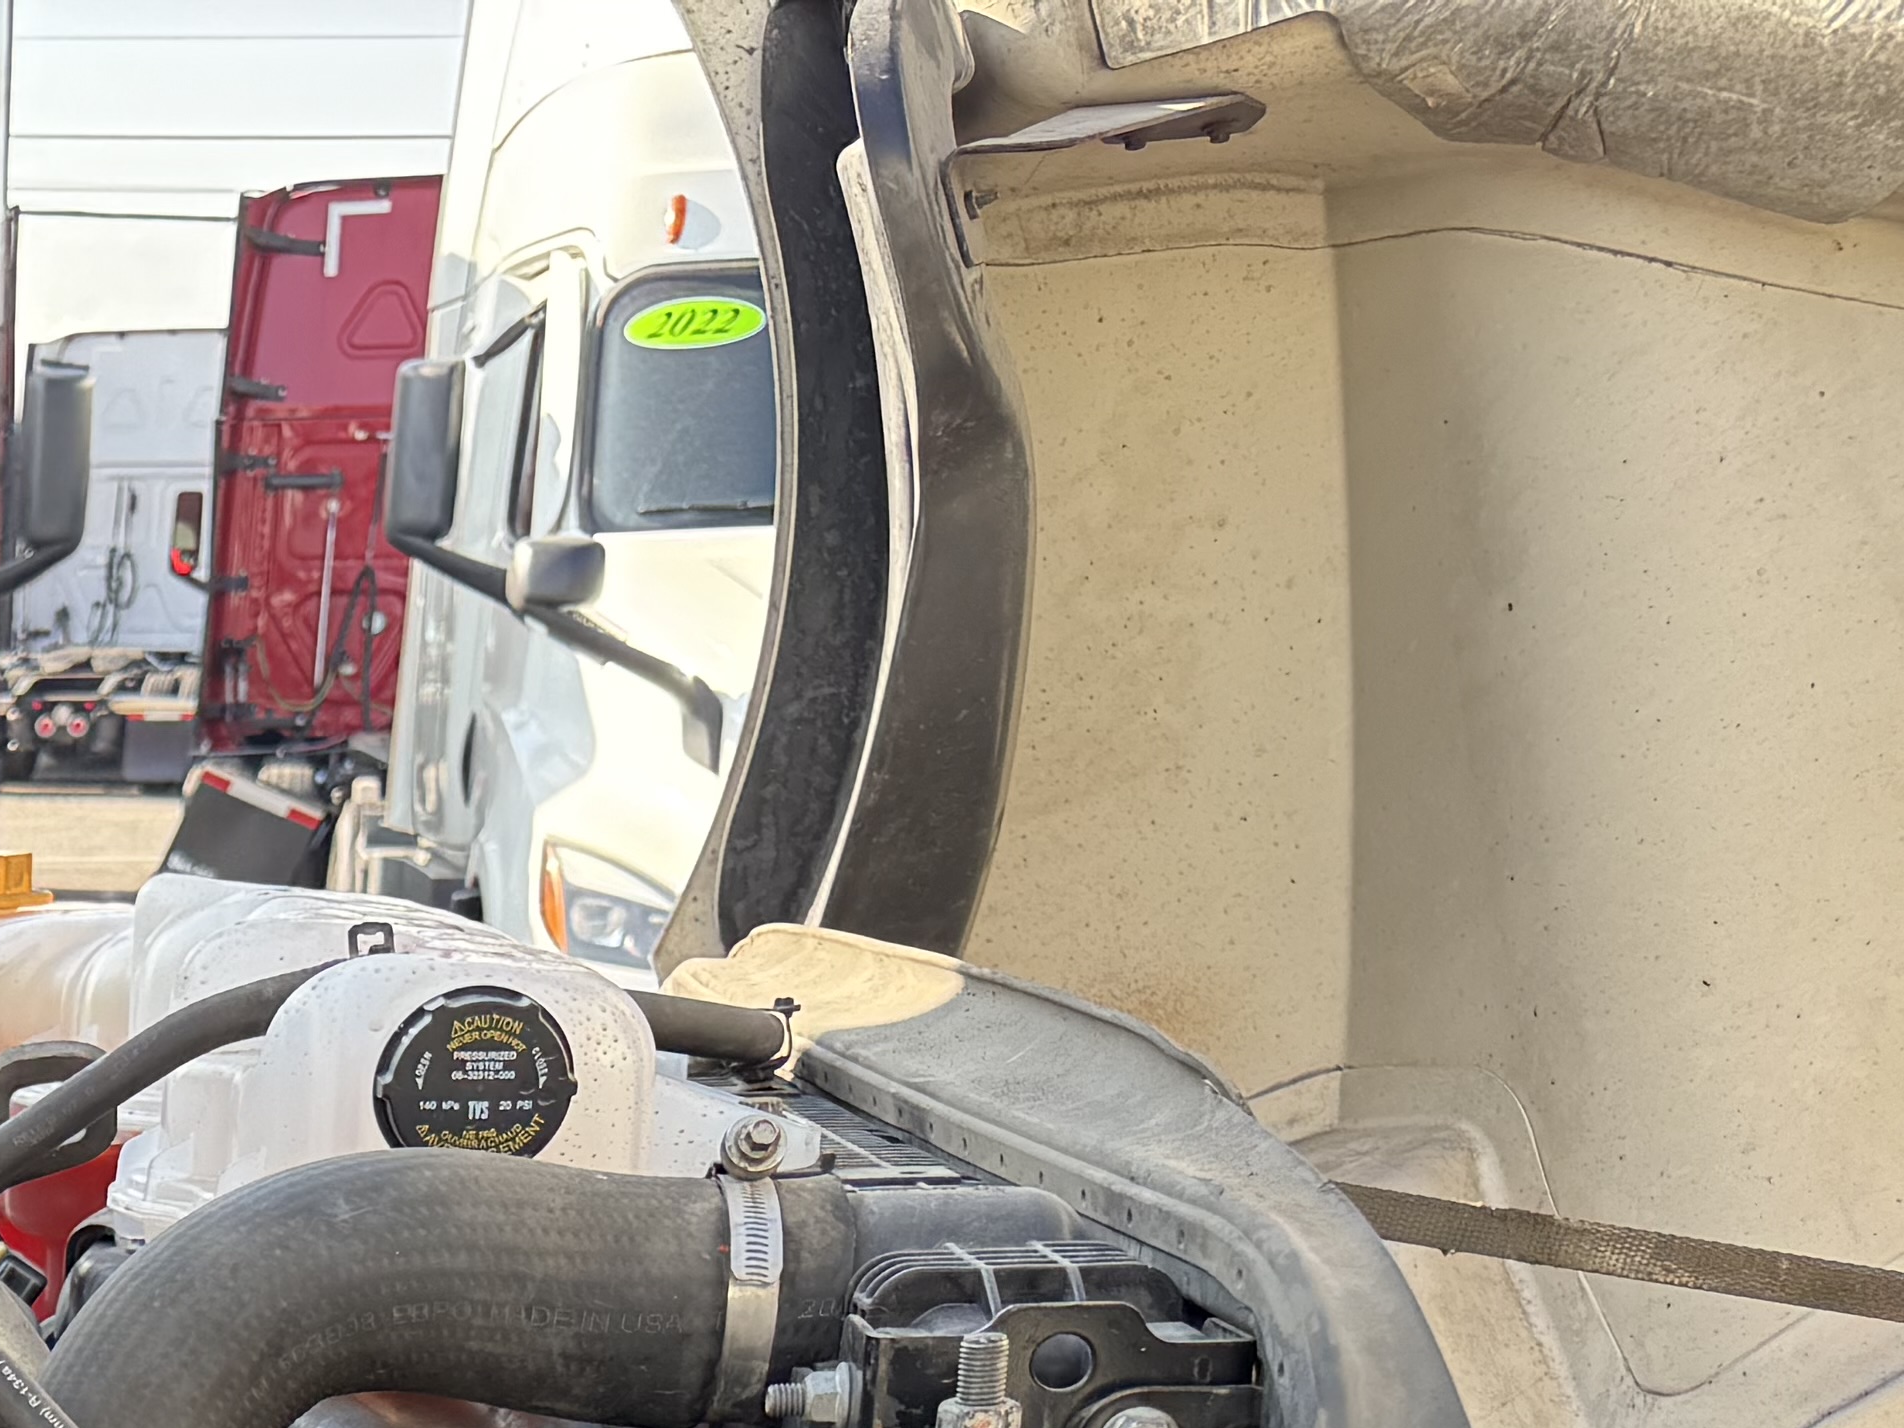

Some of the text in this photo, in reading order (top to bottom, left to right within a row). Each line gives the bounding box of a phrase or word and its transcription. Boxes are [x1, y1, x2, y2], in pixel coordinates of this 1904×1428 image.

[647, 307, 740, 338] 2022
[465, 1014, 524, 1035] CAUTION
[447, 1031, 479, 1051] NEVER
[453, 1051, 517, 1060] PRESSURIZED
[465, 1061, 504, 1070] SYSTEM
[419, 1101, 437, 1110] 140
[468, 1101, 489, 1120] TVS
[499, 1101, 533, 1110] 20 PSI
[621, 1311, 684, 1334] USA
